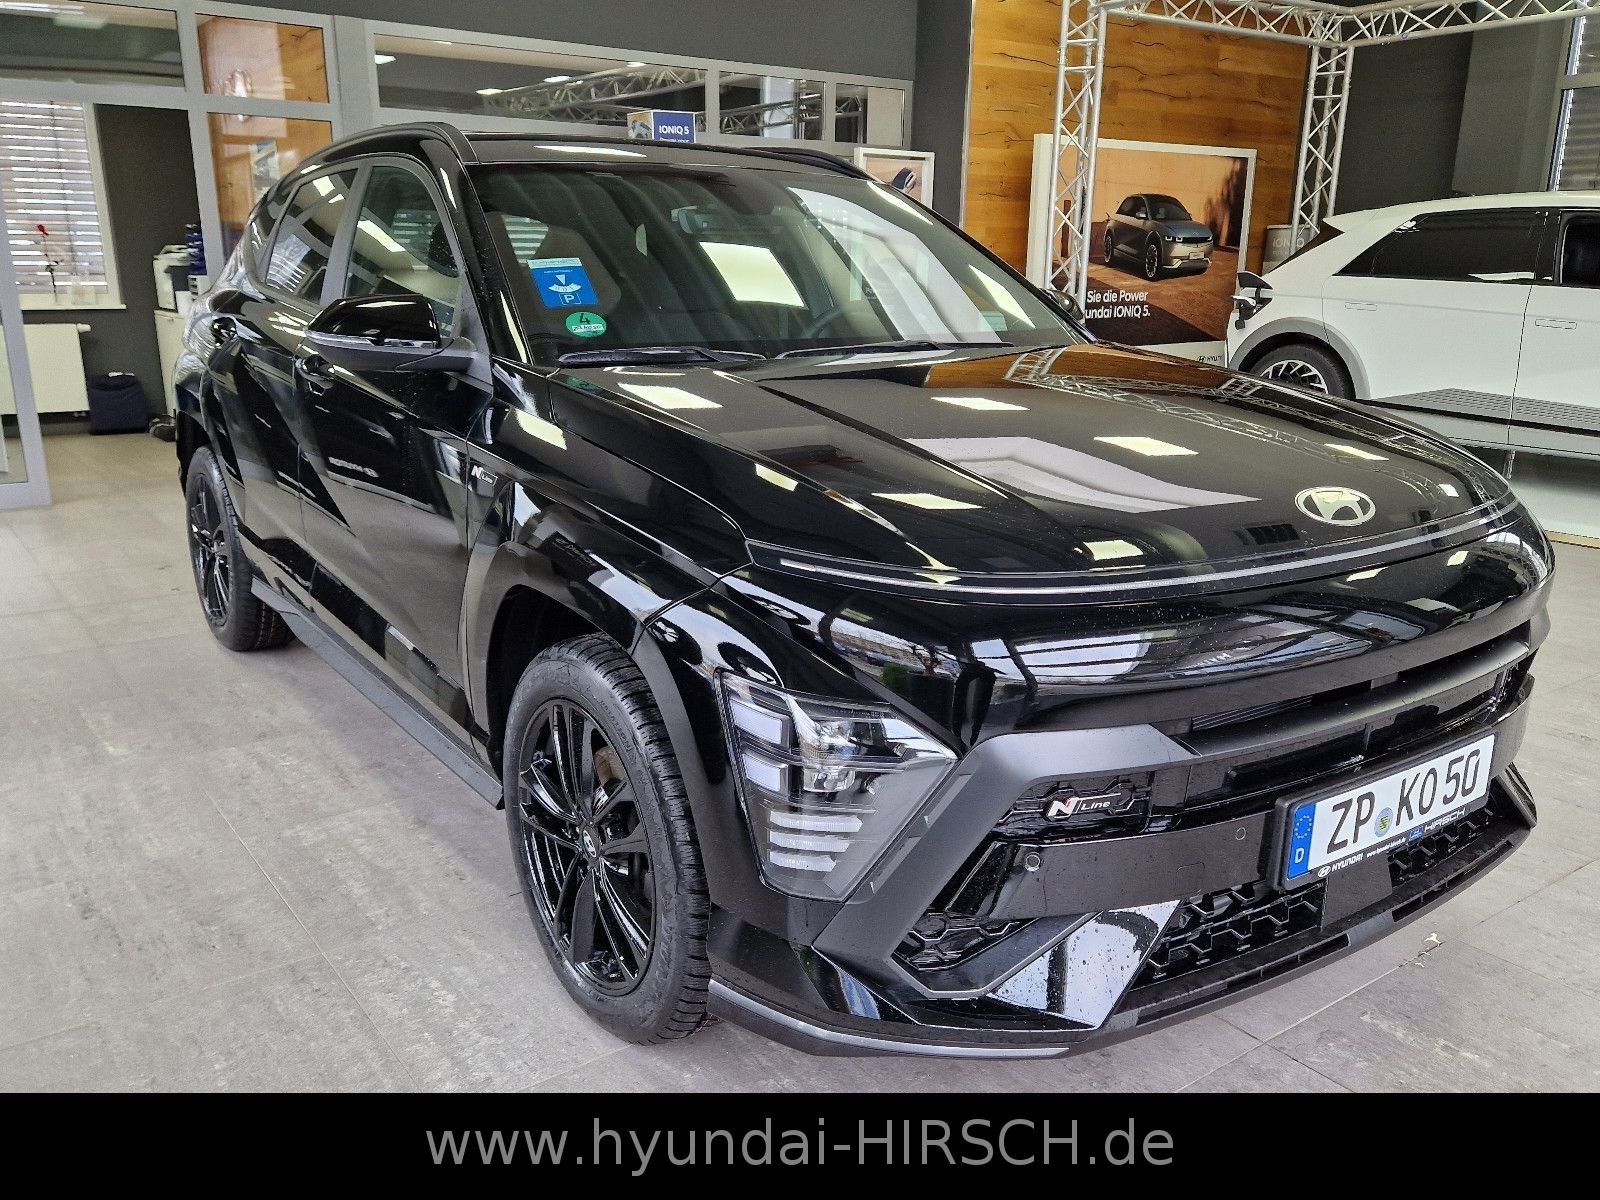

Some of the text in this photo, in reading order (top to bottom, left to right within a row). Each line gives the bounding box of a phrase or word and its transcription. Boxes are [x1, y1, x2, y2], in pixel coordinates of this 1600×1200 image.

[658, 125, 690, 135] IONIQ 5
[1086, 290, 1148, 303] Sie die Power
[579, 312, 591, 325] 4
[1085, 305, 1151, 319] undai IONIQ 5.
[1046, 796, 1081, 818] N
[1326, 748, 1480, 855] ZP KO 50
[1331, 852, 1364, 872] HYUNDAI
[1424, 809, 1465, 832] HIRSCH
[1294, 847, 1305, 864] D
